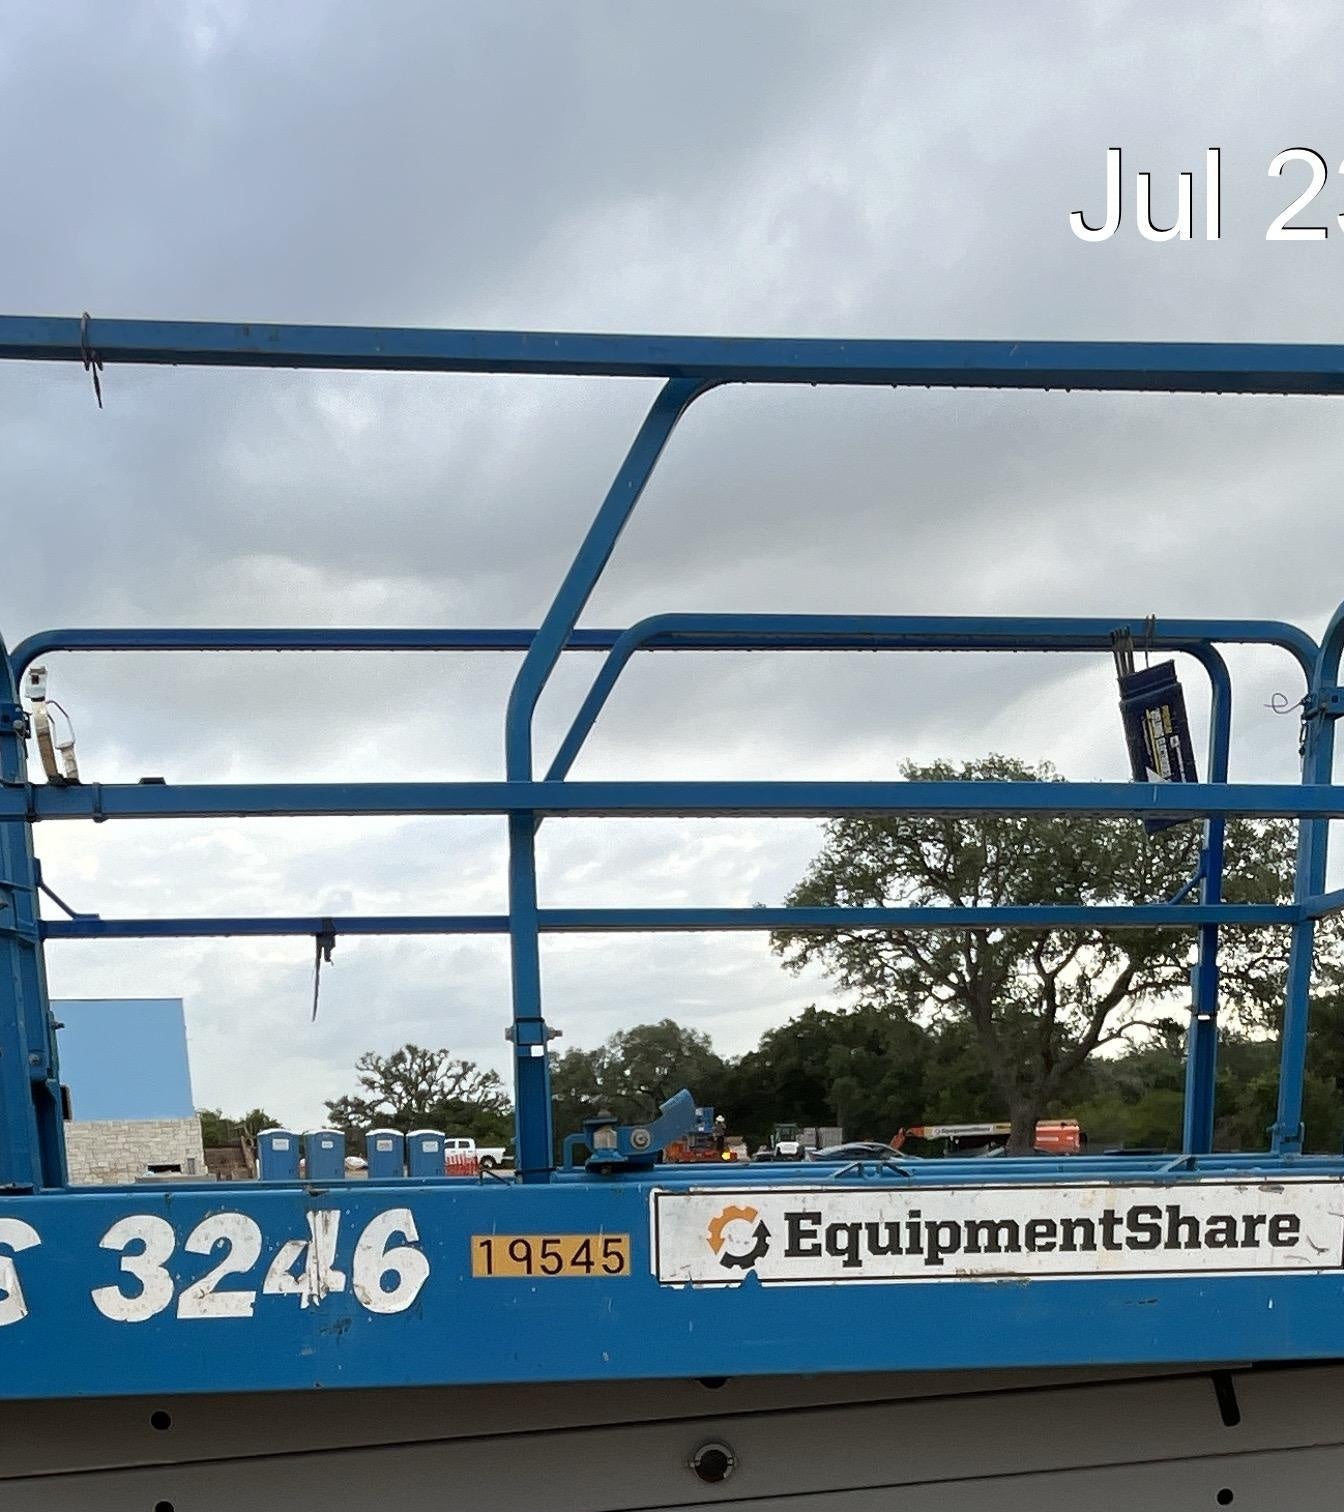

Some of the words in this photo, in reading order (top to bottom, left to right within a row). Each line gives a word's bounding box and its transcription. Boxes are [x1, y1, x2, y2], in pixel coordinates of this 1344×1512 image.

[91, 1208, 431, 1323] 3246
[479, 1237, 626, 1276] 19545
[783, 1204, 1302, 1268] EquipmentShare
